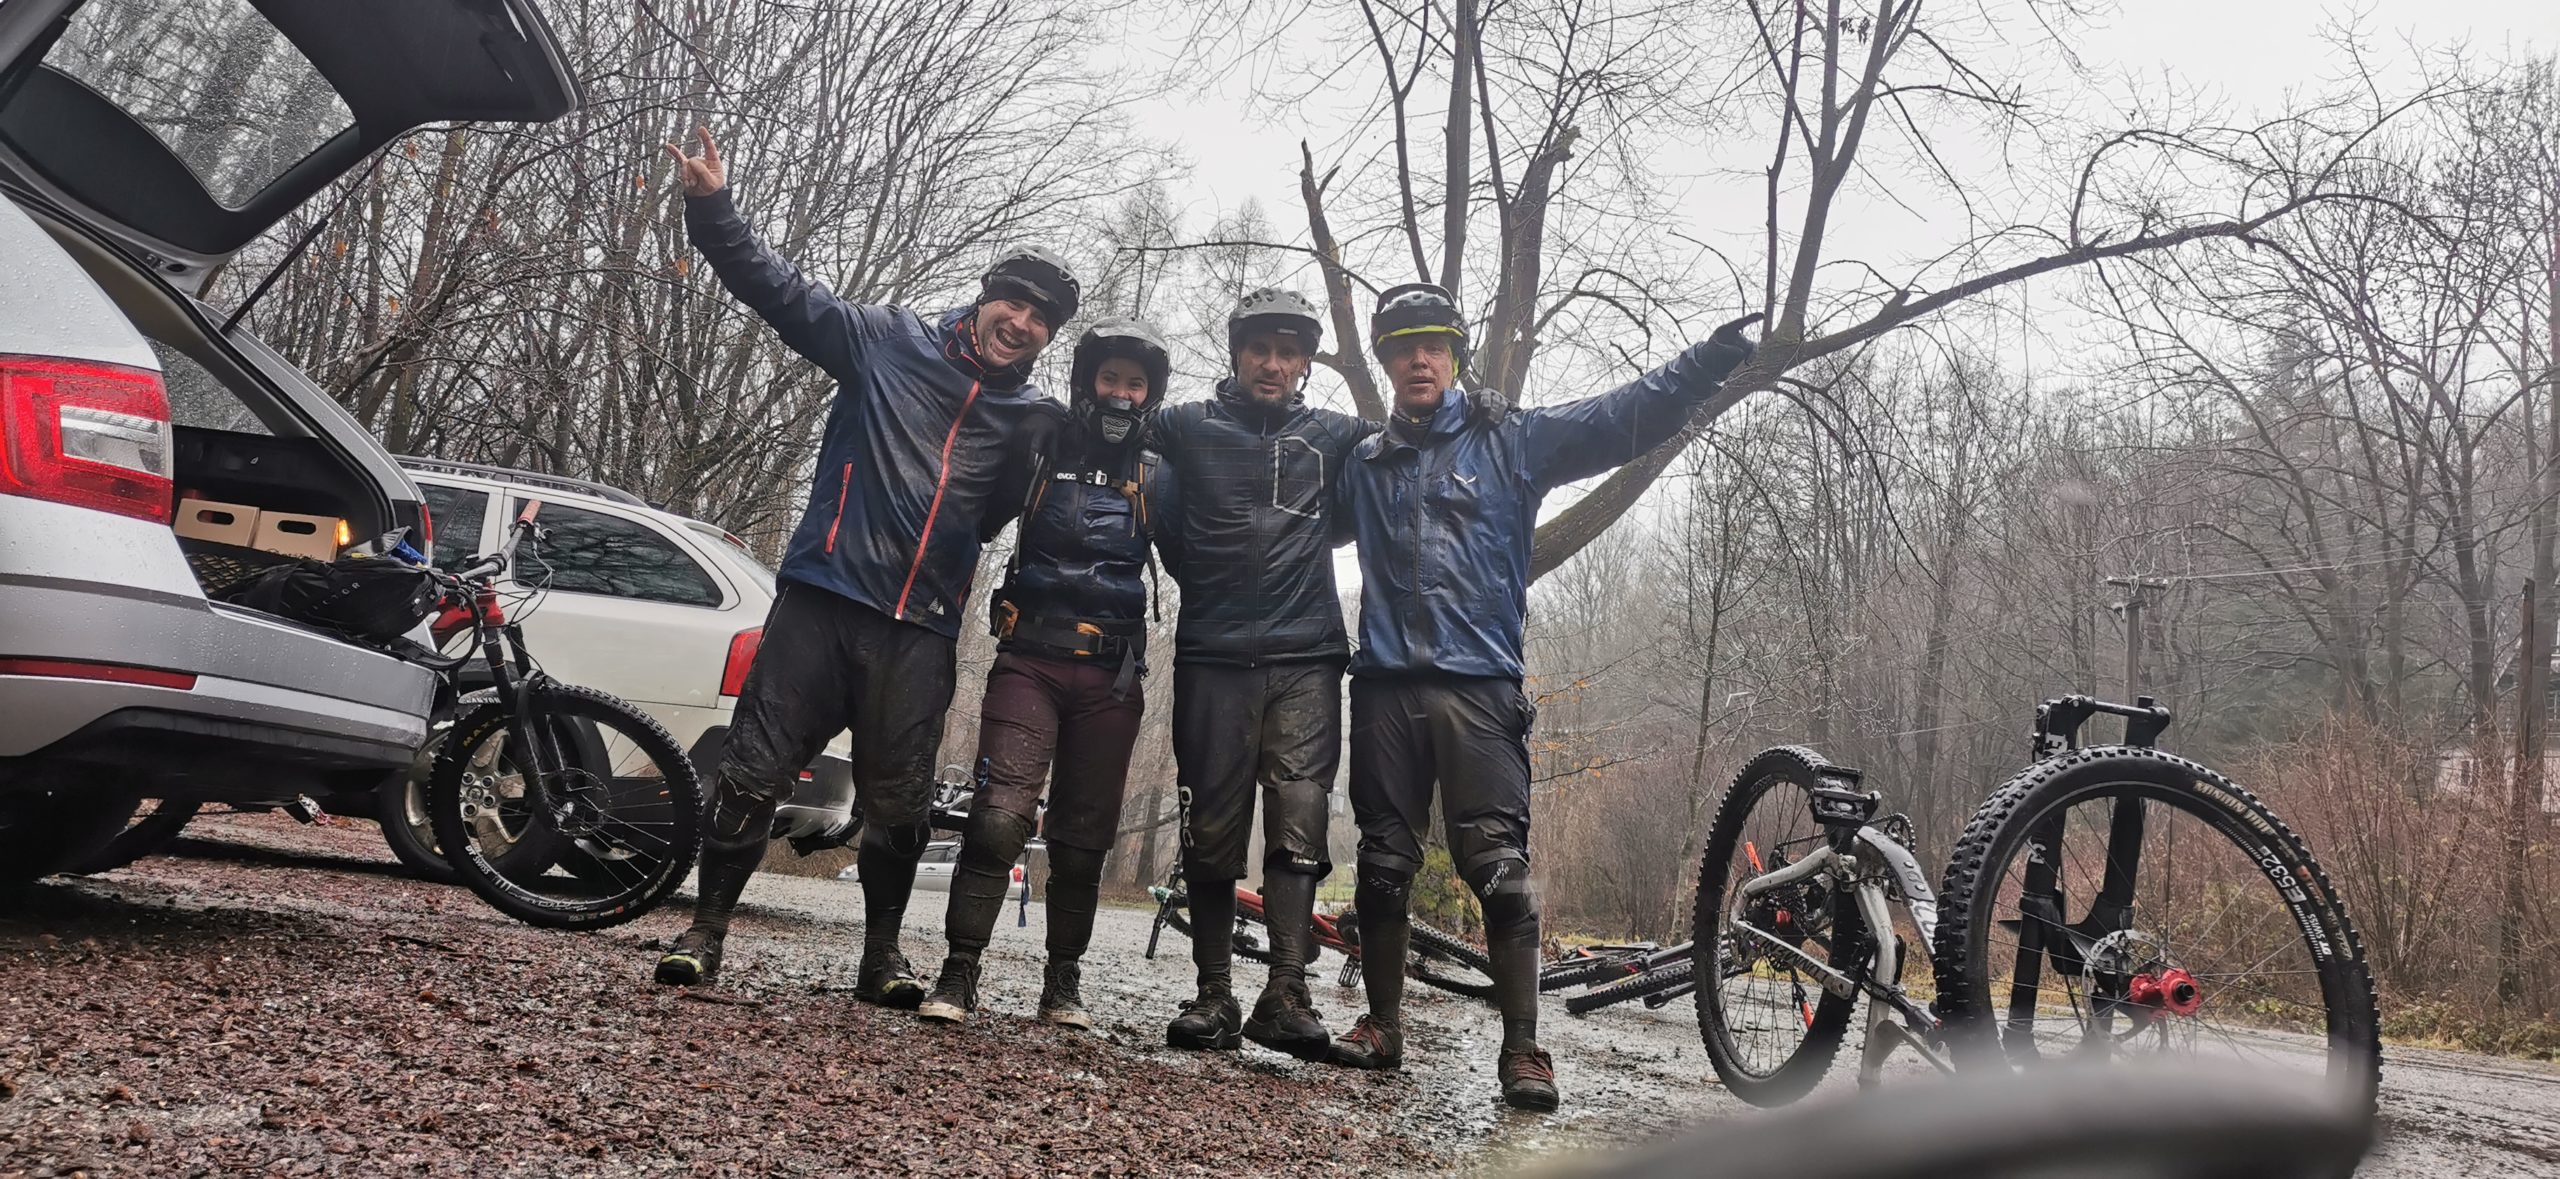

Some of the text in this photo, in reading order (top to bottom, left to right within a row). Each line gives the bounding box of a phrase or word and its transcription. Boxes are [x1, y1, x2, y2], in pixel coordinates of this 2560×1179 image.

[2193, 781, 2248, 812] MINION
[465, 845, 491, 875] DT SWISS
[2262, 853, 2307, 902] E532
[2307, 913, 2326, 939] SWISS
[2319, 940, 2332, 955] DT
